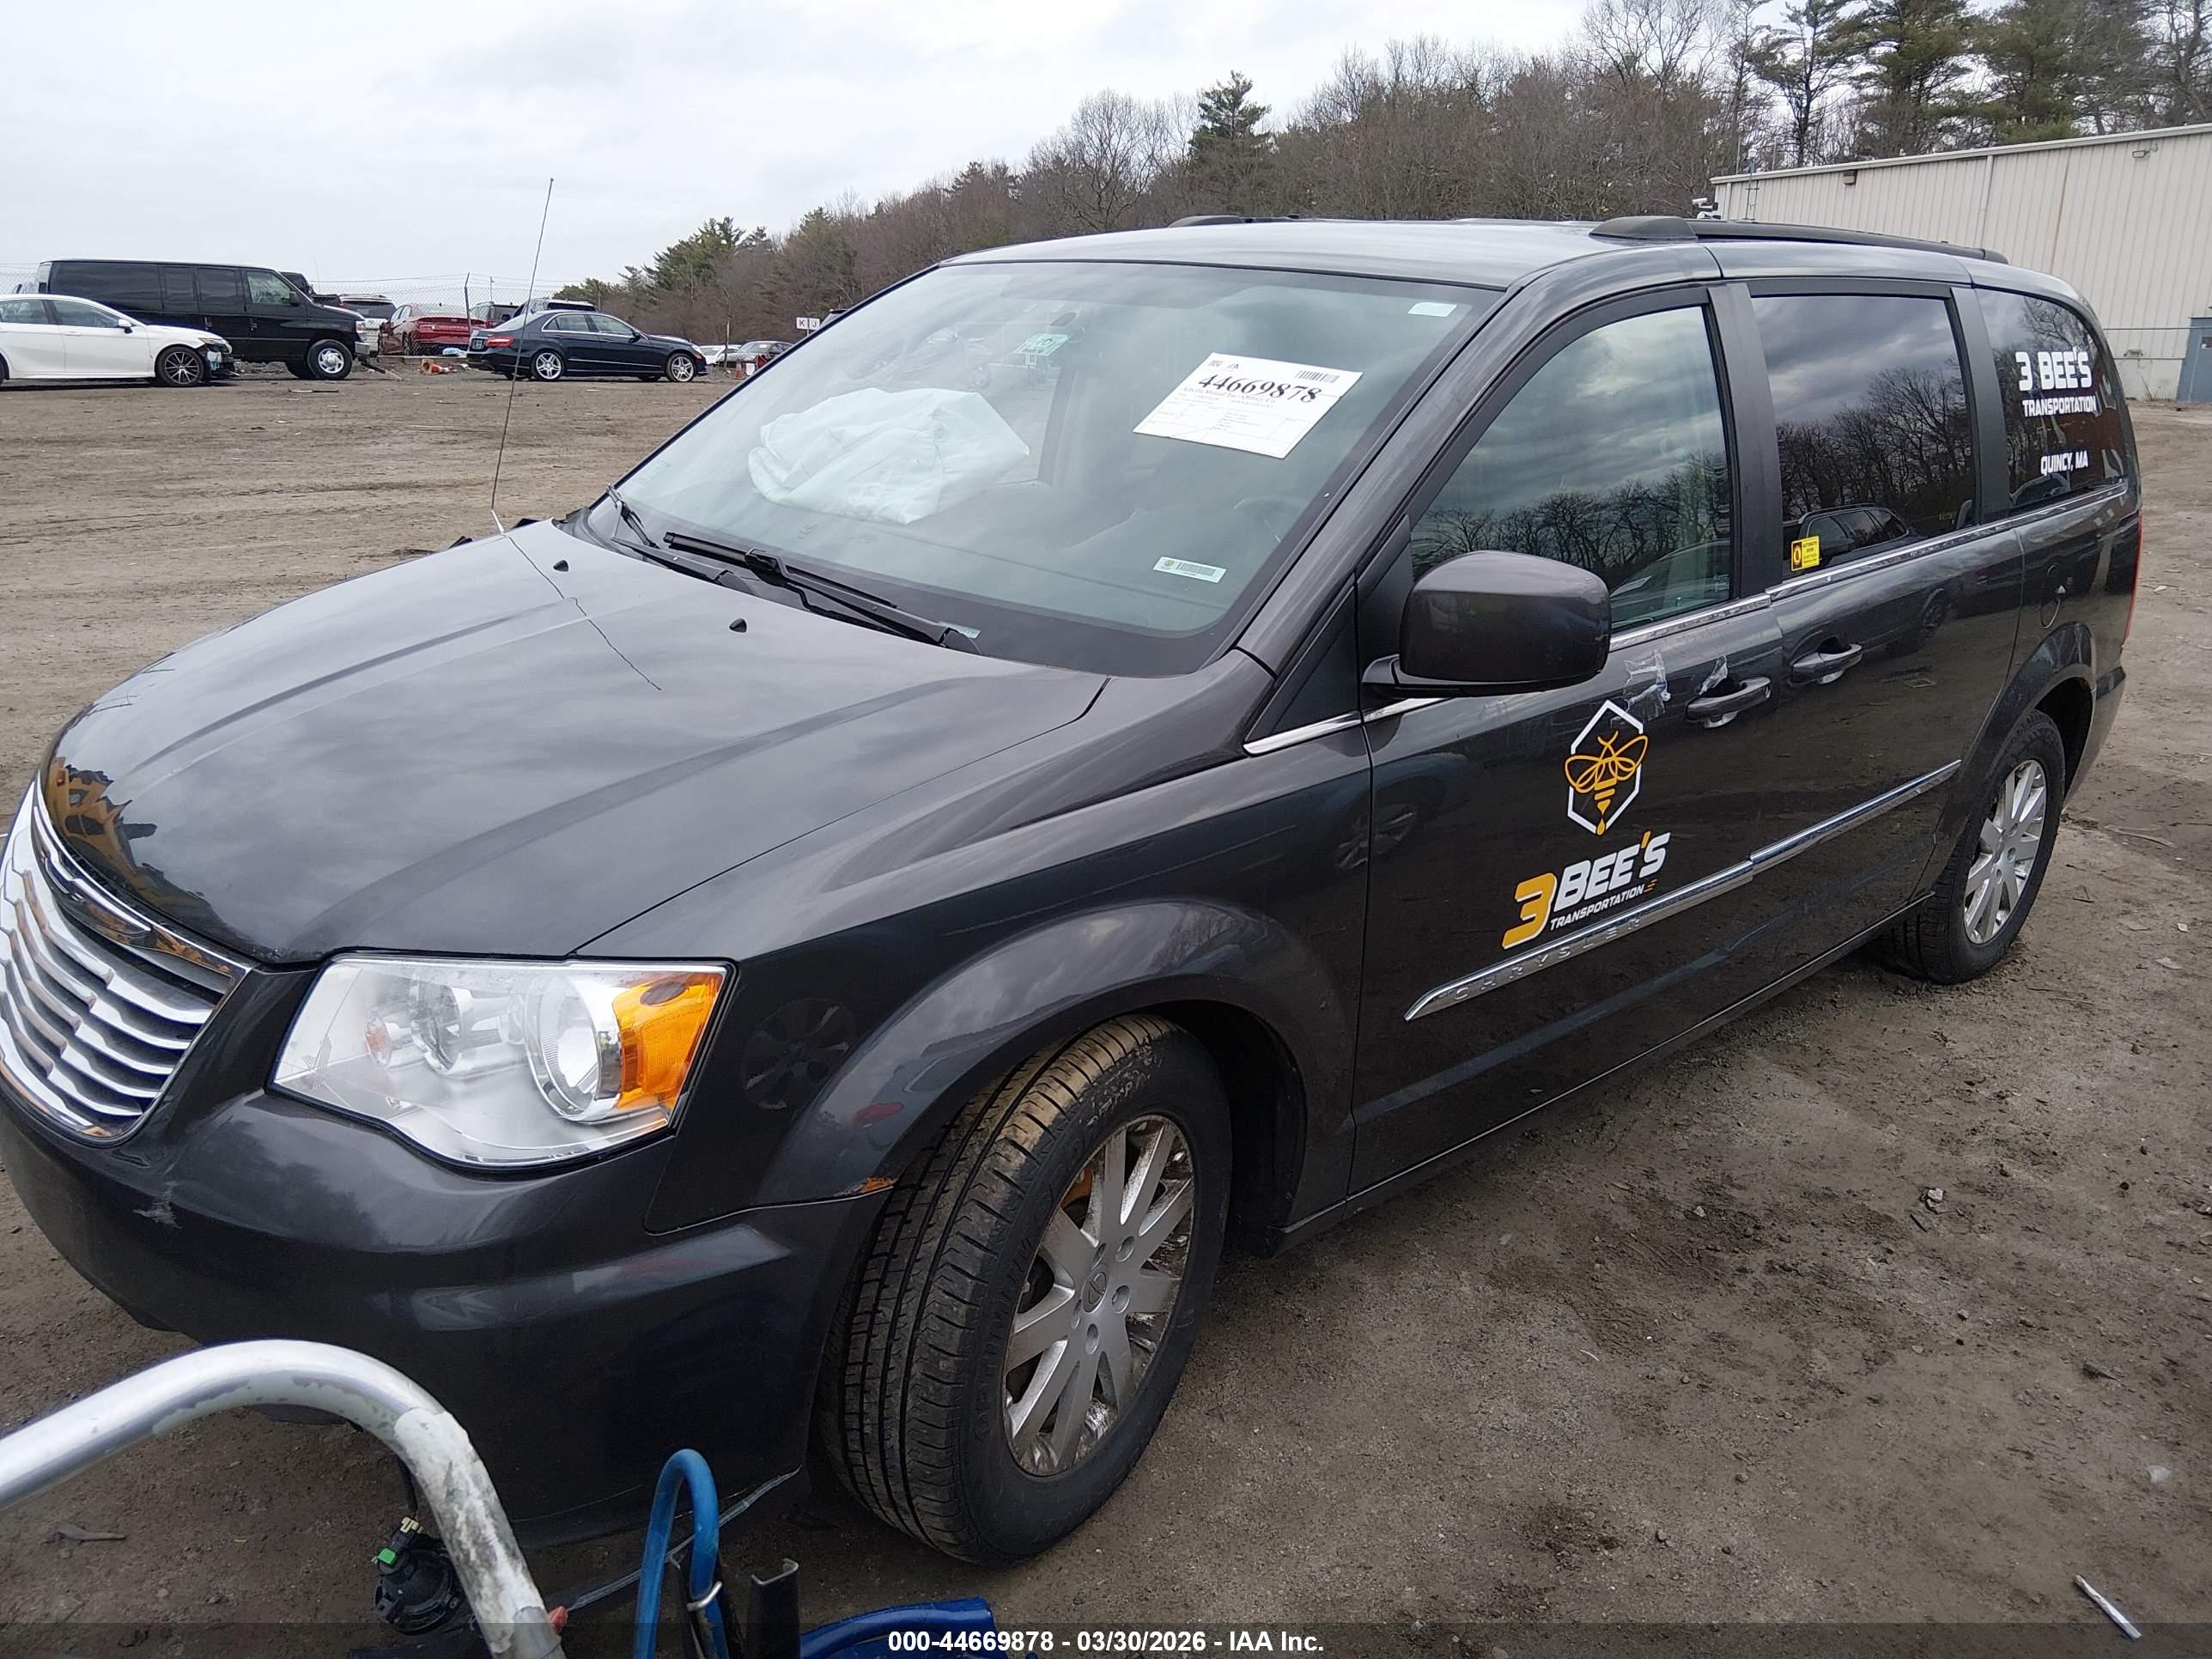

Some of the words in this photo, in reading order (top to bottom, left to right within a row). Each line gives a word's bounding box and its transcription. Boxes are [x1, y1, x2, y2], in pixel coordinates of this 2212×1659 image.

[799, 319, 806, 327] K
[2015, 351, 2033, 392] 3
[2037, 348, 2093, 390] BEE'S
[1198, 374, 1322, 403] 44669878
[2022, 396, 2097, 417] TRANSPORTATION
[2040, 452, 2074, 475] QUINCY,
[2075, 450, 2089, 469] MA
[1550, 884, 1645, 931] TRANSPORTATION
[1453, 918, 1641, 1001] CHRYSLER
